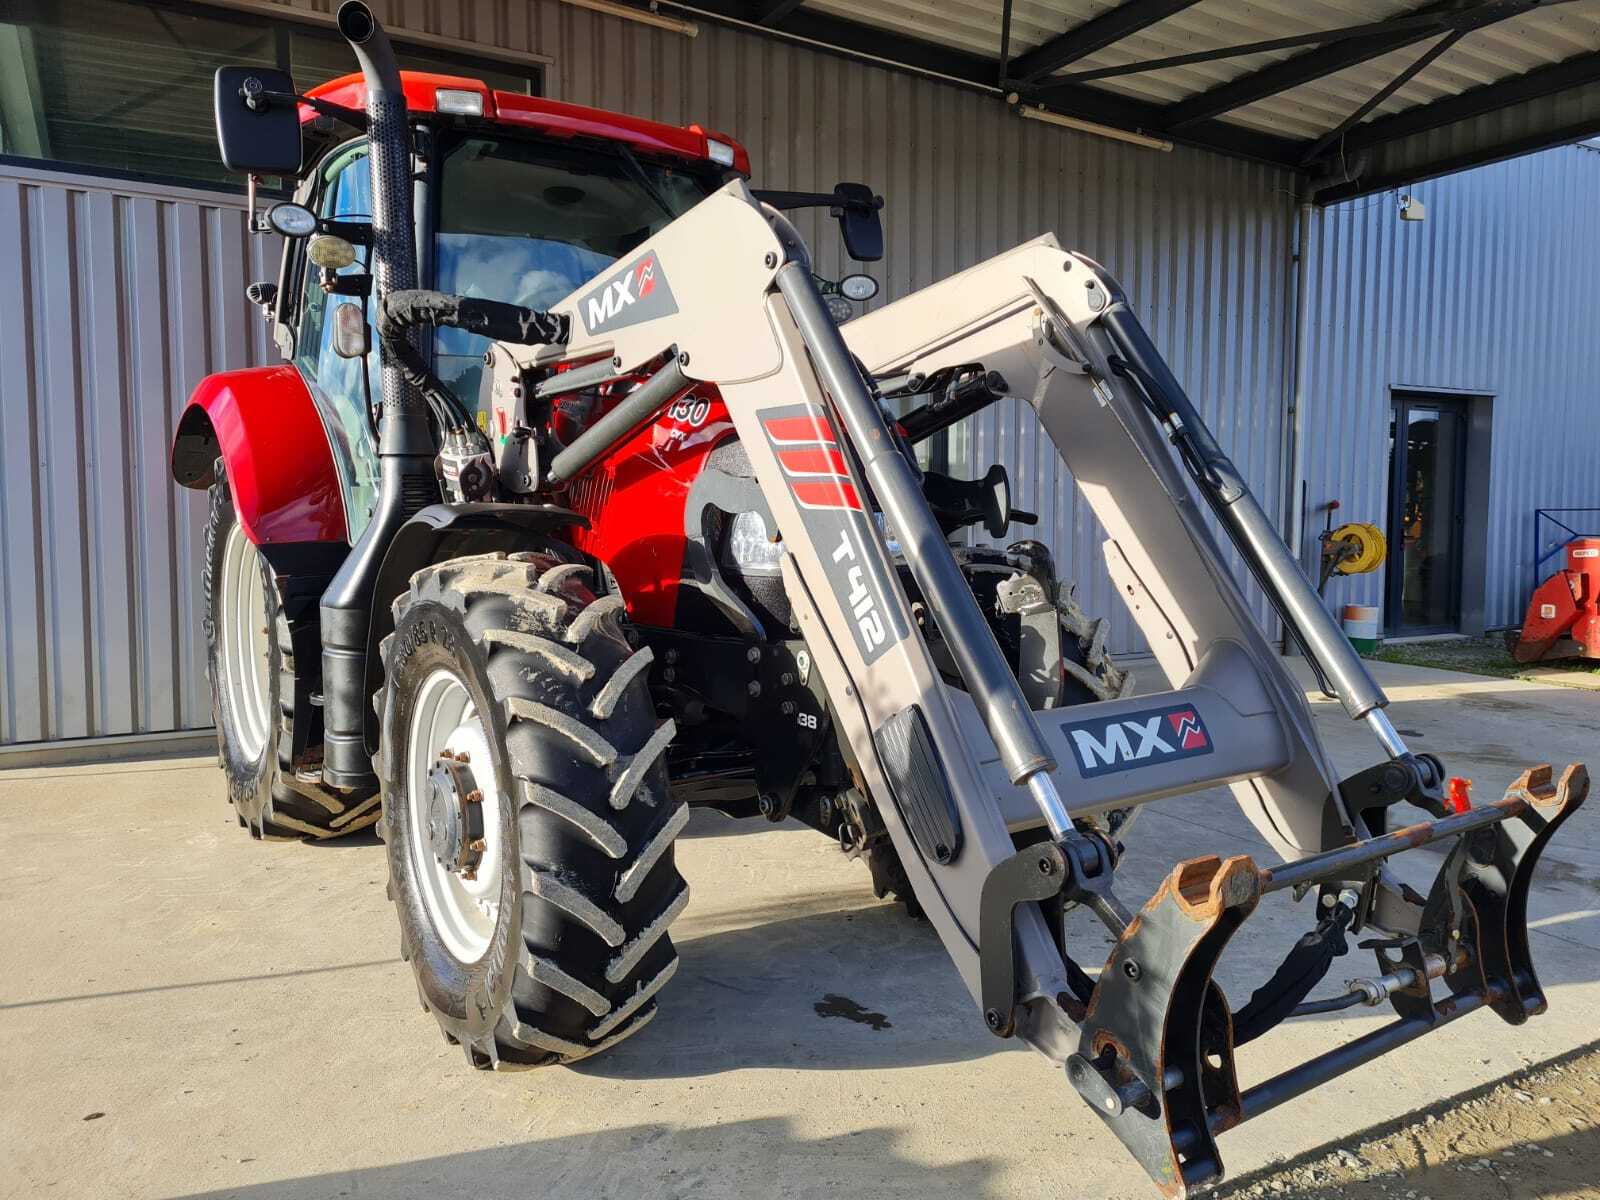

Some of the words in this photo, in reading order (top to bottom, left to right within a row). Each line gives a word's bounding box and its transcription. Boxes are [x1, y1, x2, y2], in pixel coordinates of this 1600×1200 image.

[588, 270, 636, 330] MX
[667, 393, 711, 427] 130
[832, 529, 886, 653] T412
[1071, 715, 1177, 769] MX
